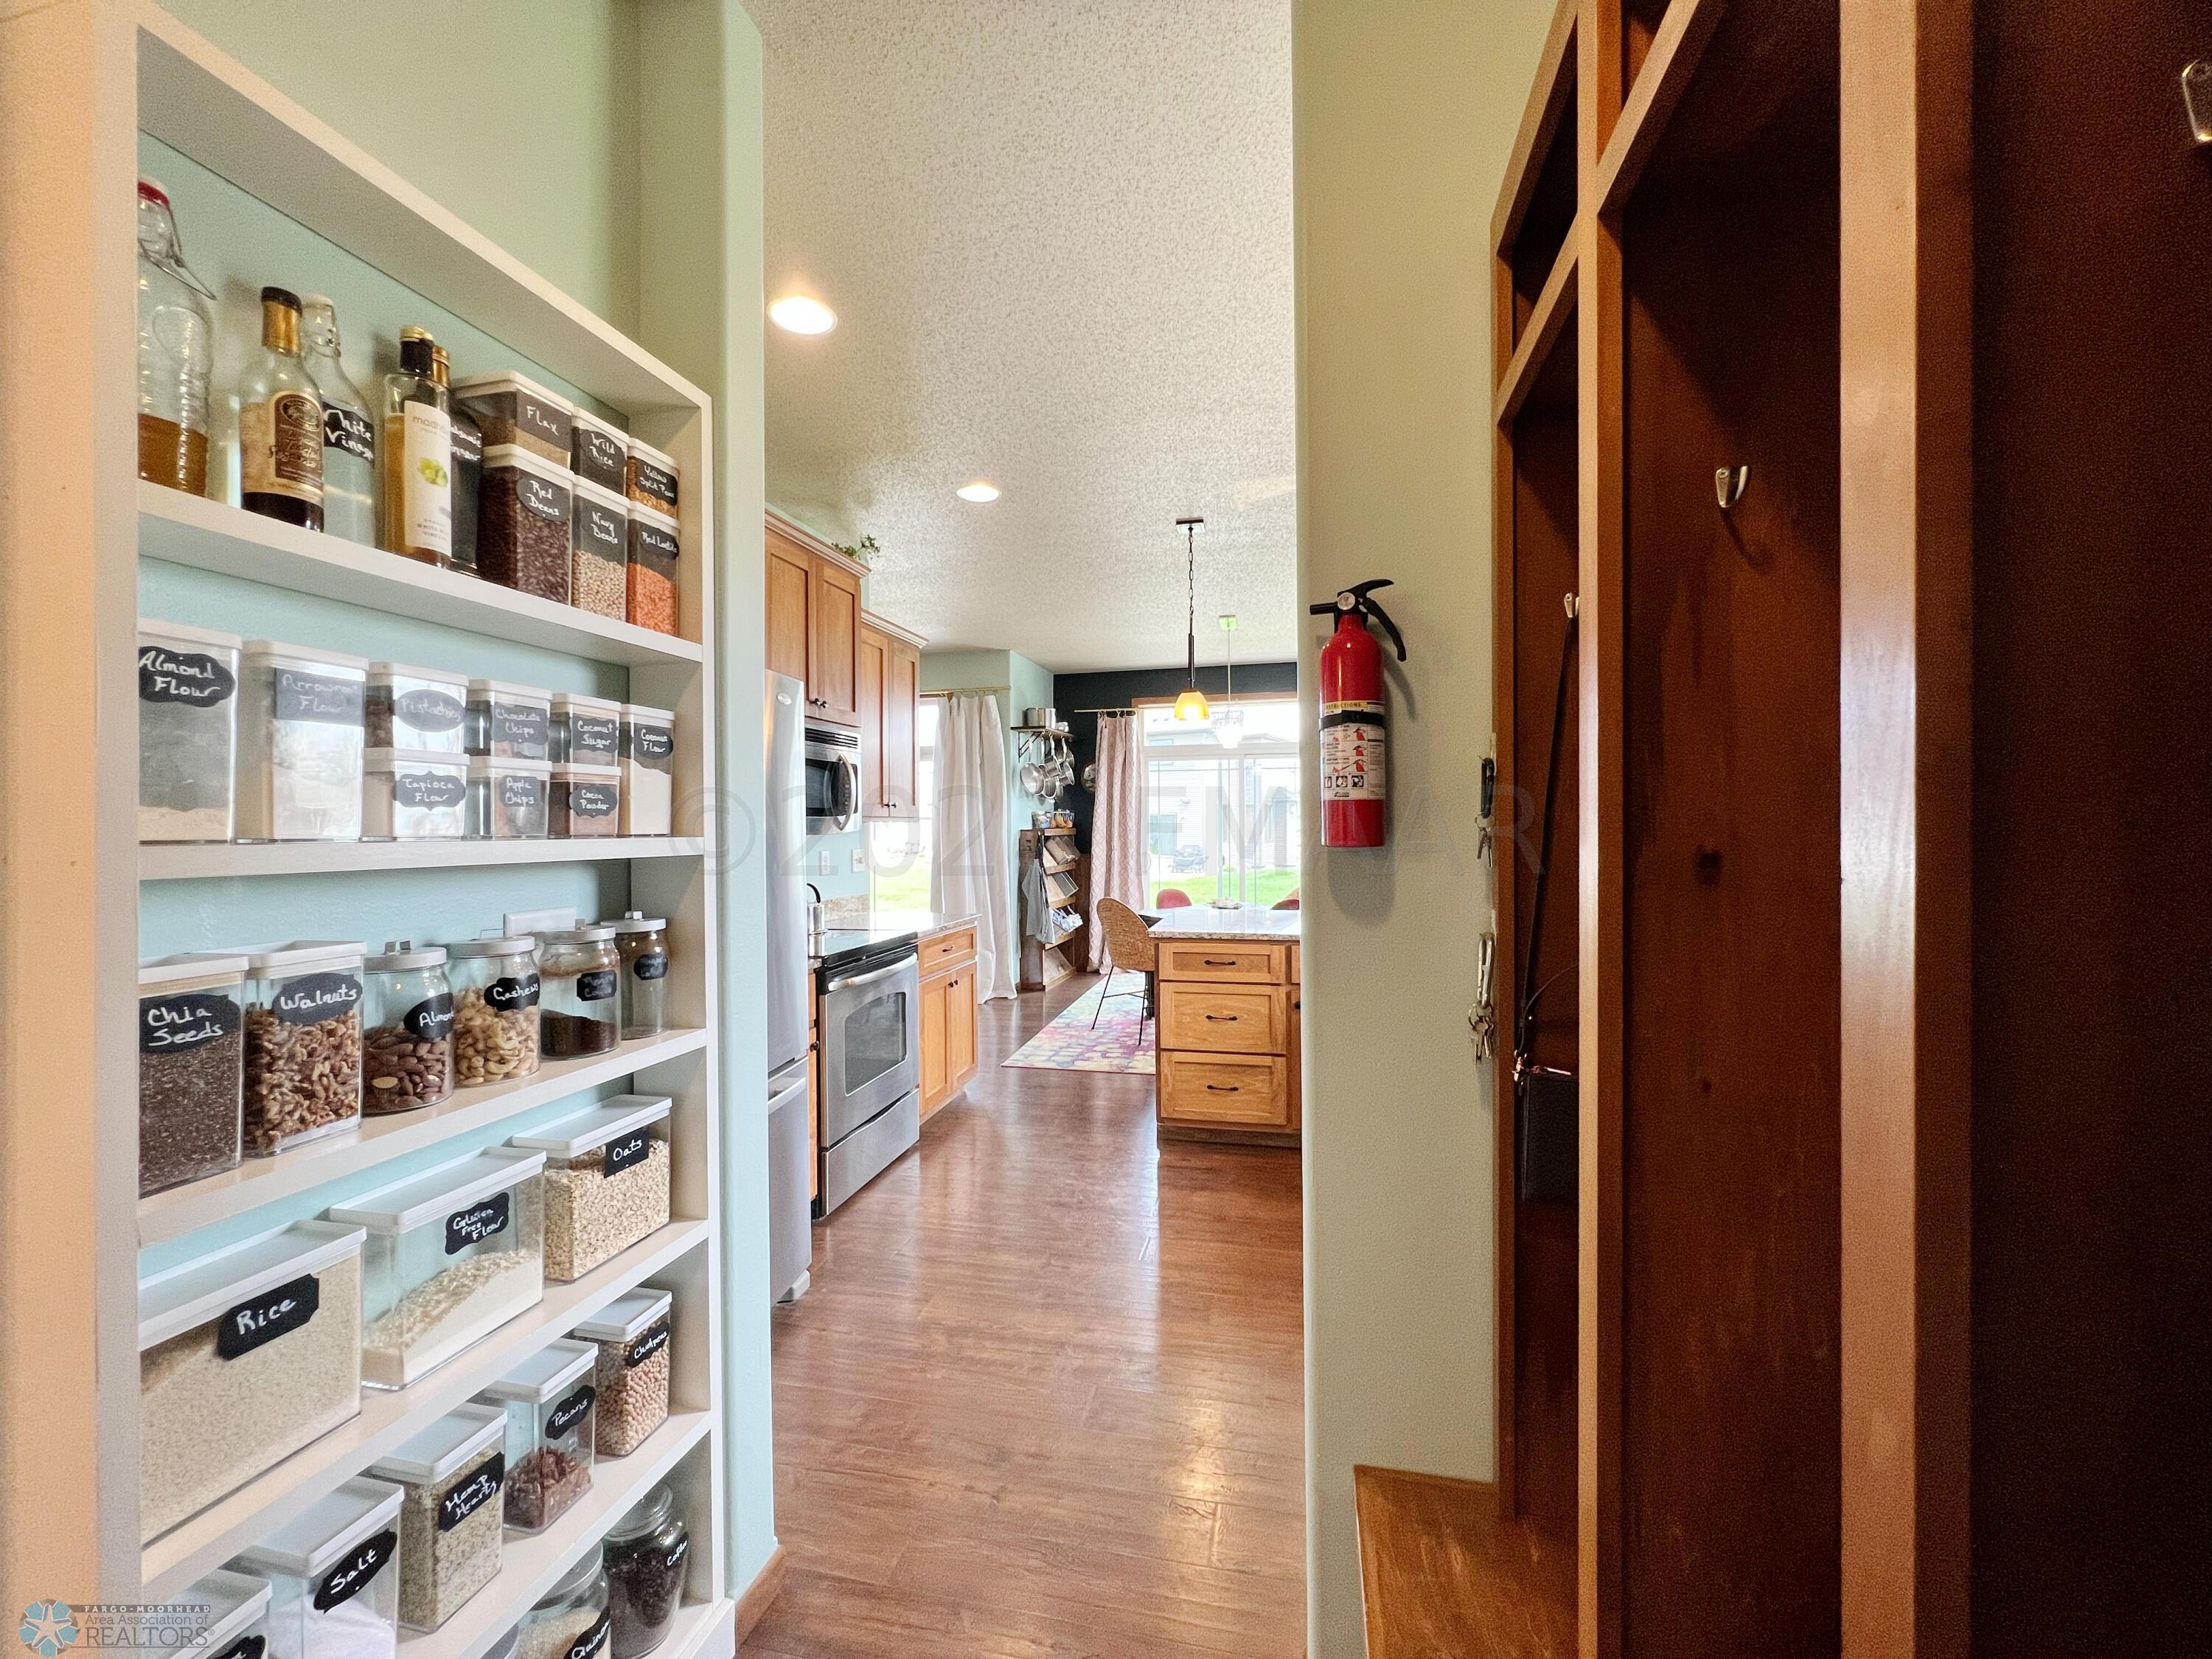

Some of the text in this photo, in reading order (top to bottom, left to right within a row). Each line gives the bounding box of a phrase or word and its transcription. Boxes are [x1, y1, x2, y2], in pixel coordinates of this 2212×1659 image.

[526, 405, 558, 436] Flax
[589, 446, 614, 468] Rice
[530, 480, 553, 500] Red
[139, 650, 215, 679] Almond
[153, 676, 220, 697] Flour
[280, 984, 358, 1010] Walnuts
[147, 1006, 212, 1026] Chia
[149, 1021, 223, 1046] Seeds
[613, 1139, 642, 1161] Oats
[236, 1299, 296, 1335] Rice
[552, 1399, 588, 1427] Pecans
[330, 1548, 377, 1594] Salt
